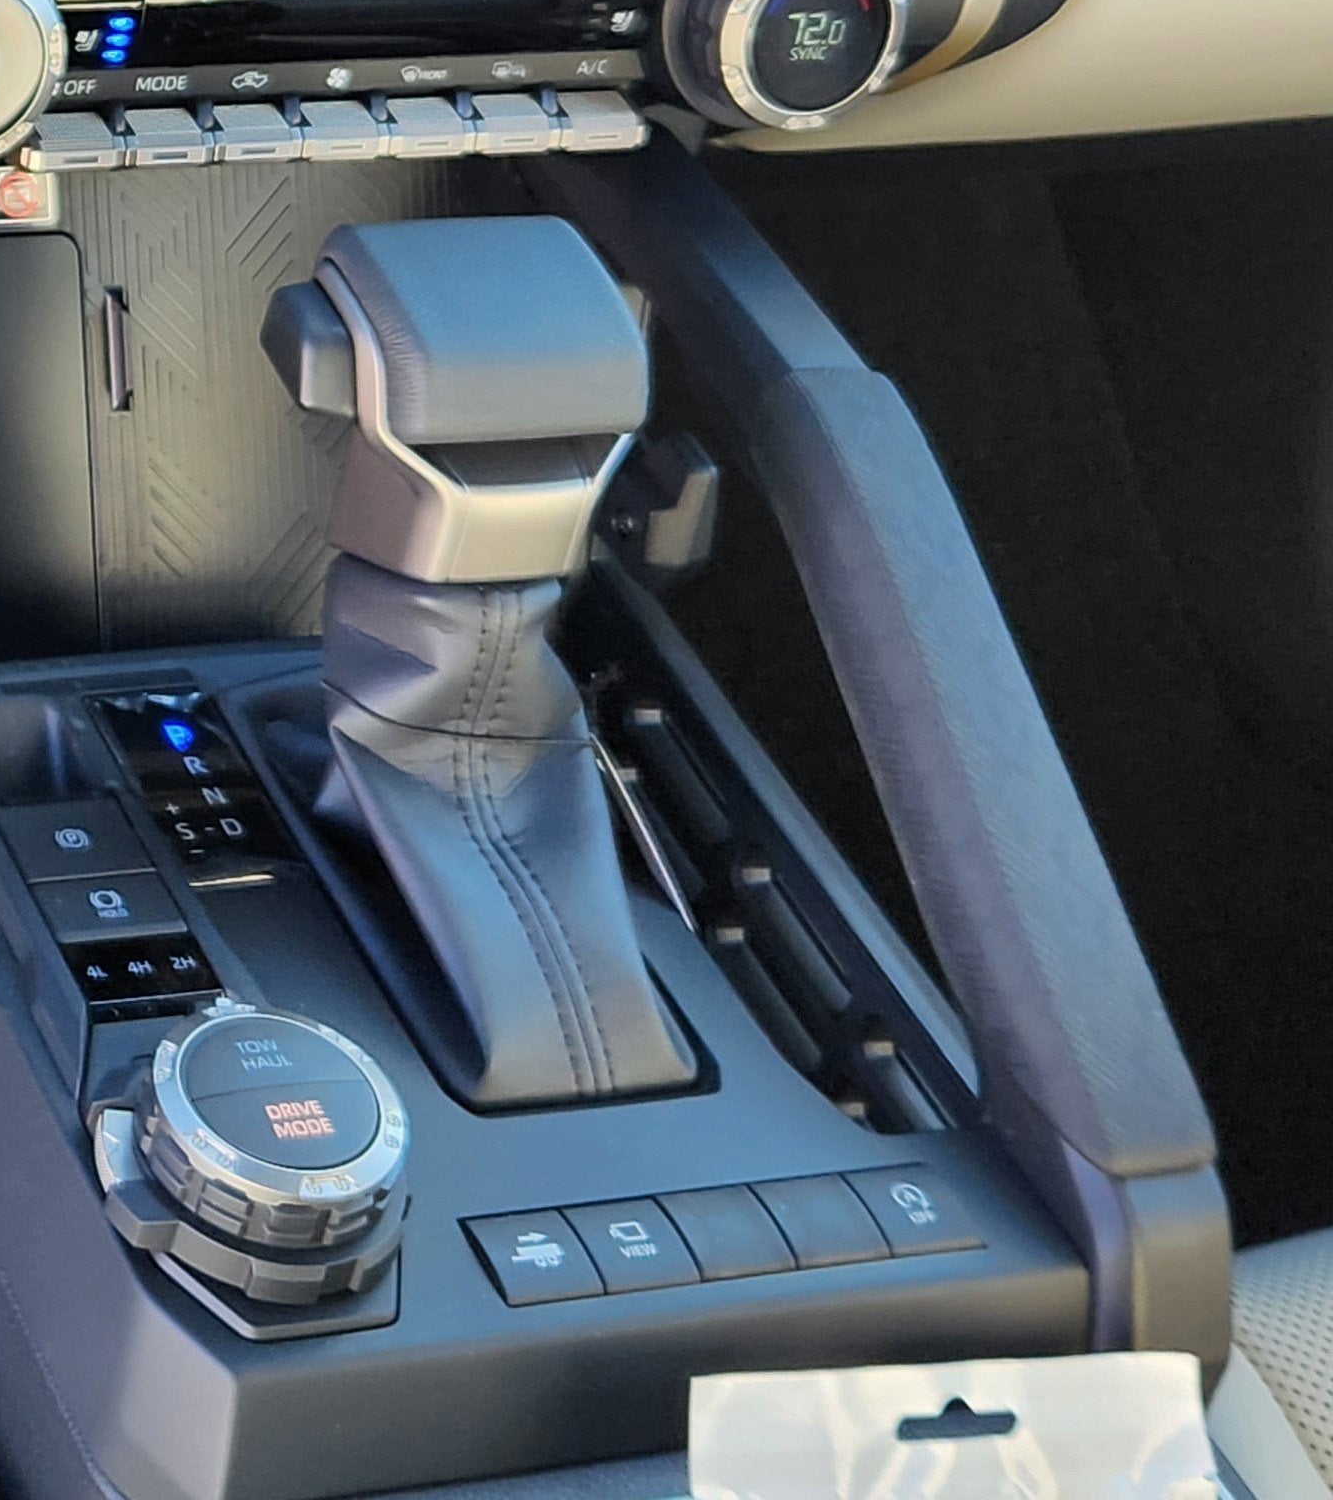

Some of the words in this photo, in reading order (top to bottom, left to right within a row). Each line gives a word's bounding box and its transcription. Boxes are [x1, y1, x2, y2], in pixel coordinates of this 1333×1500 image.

[788, 12, 846, 45] 72.0
[790, 46, 829, 61] SYNC
[576, 59, 610, 76] A/C
[64, 79, 97, 95] OFF
[135, 75, 188, 92] MODE
[183, 756, 210, 775] R
[201, 787, 229, 805] N
[175, 823, 195, 840] S
[220, 818, 243, 836] D
[86, 965, 108, 978] 4L
[128, 960, 153, 974] 4H
[169, 956, 197, 970] 2H
[235, 1039, 278, 1054] TOW
[240, 1054, 293, 1070] HAUL
[265, 1100, 325, 1120] DRIVE
[273, 1117, 335, 1138] MODE
[619, 1240, 657, 1259] VIEW
